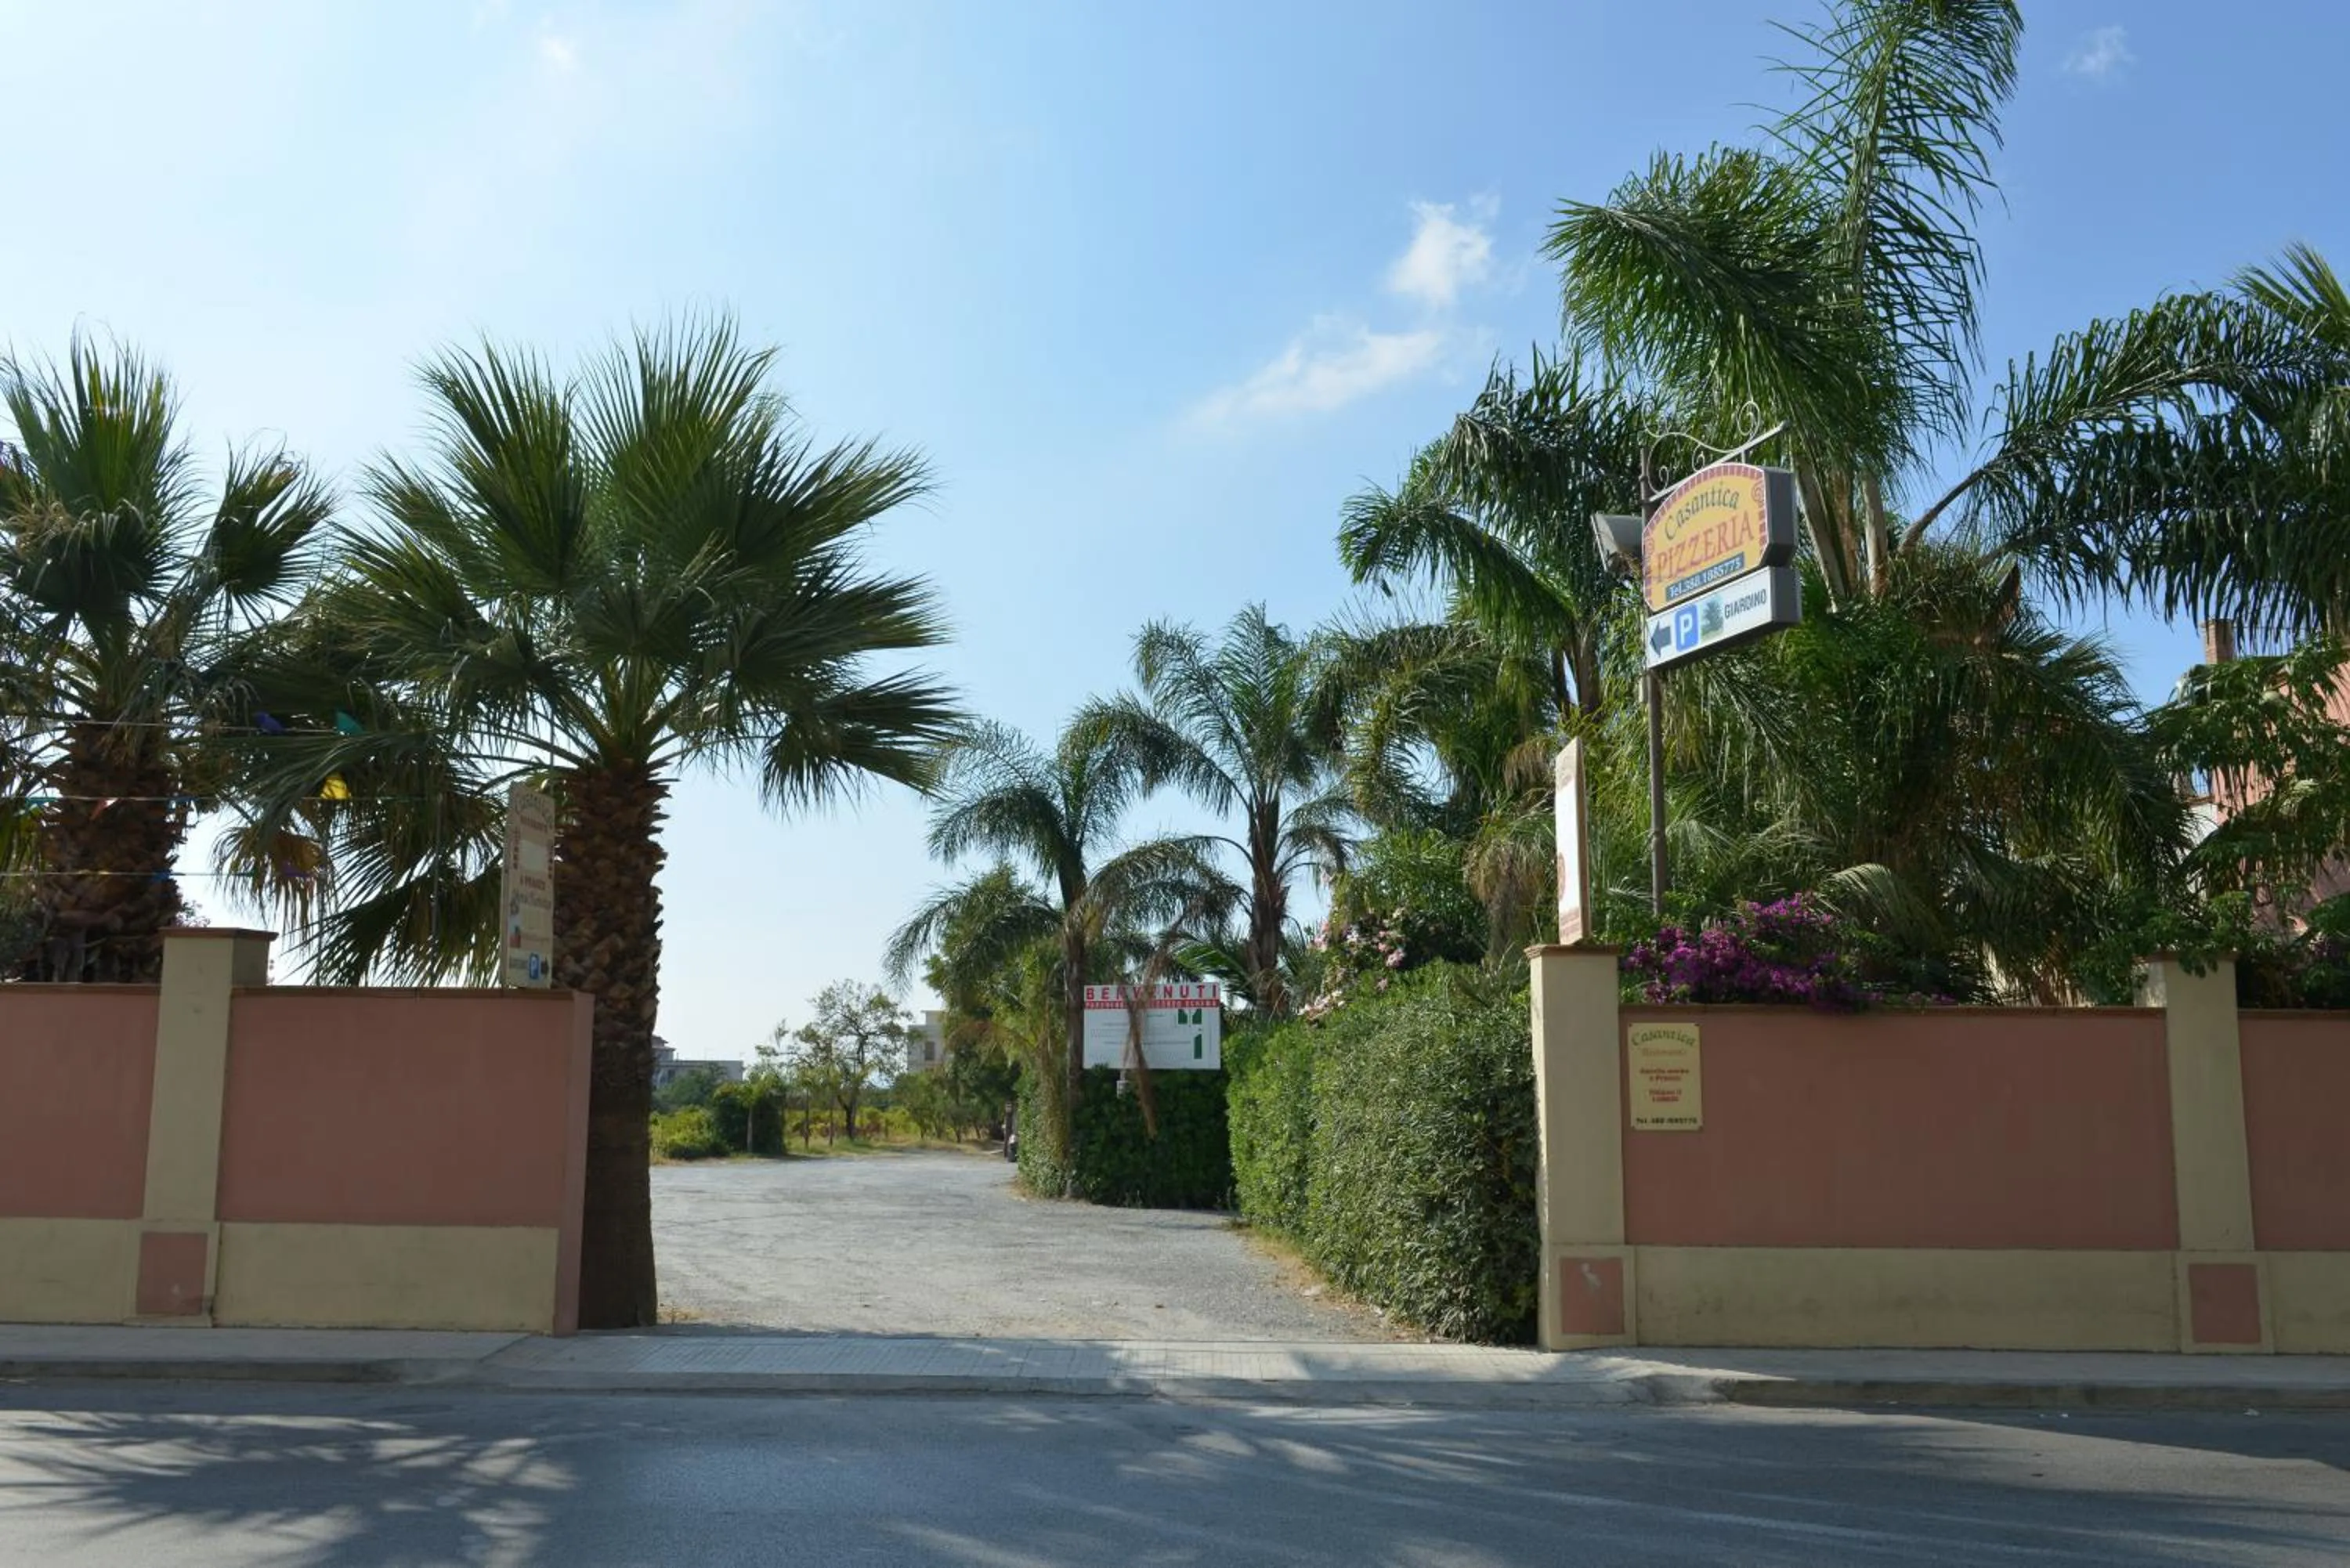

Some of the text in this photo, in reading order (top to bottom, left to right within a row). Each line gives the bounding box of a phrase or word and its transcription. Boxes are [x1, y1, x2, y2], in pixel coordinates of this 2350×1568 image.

[1665, 482, 1740, 540] Casantica
[1654, 510, 1755, 583] PIZZERIA
[1679, 589, 1767, 646] P GIARDINO
[1086, 985, 1217, 999] BENVNUTI
[1631, 1029, 1696, 1046] Casantica
